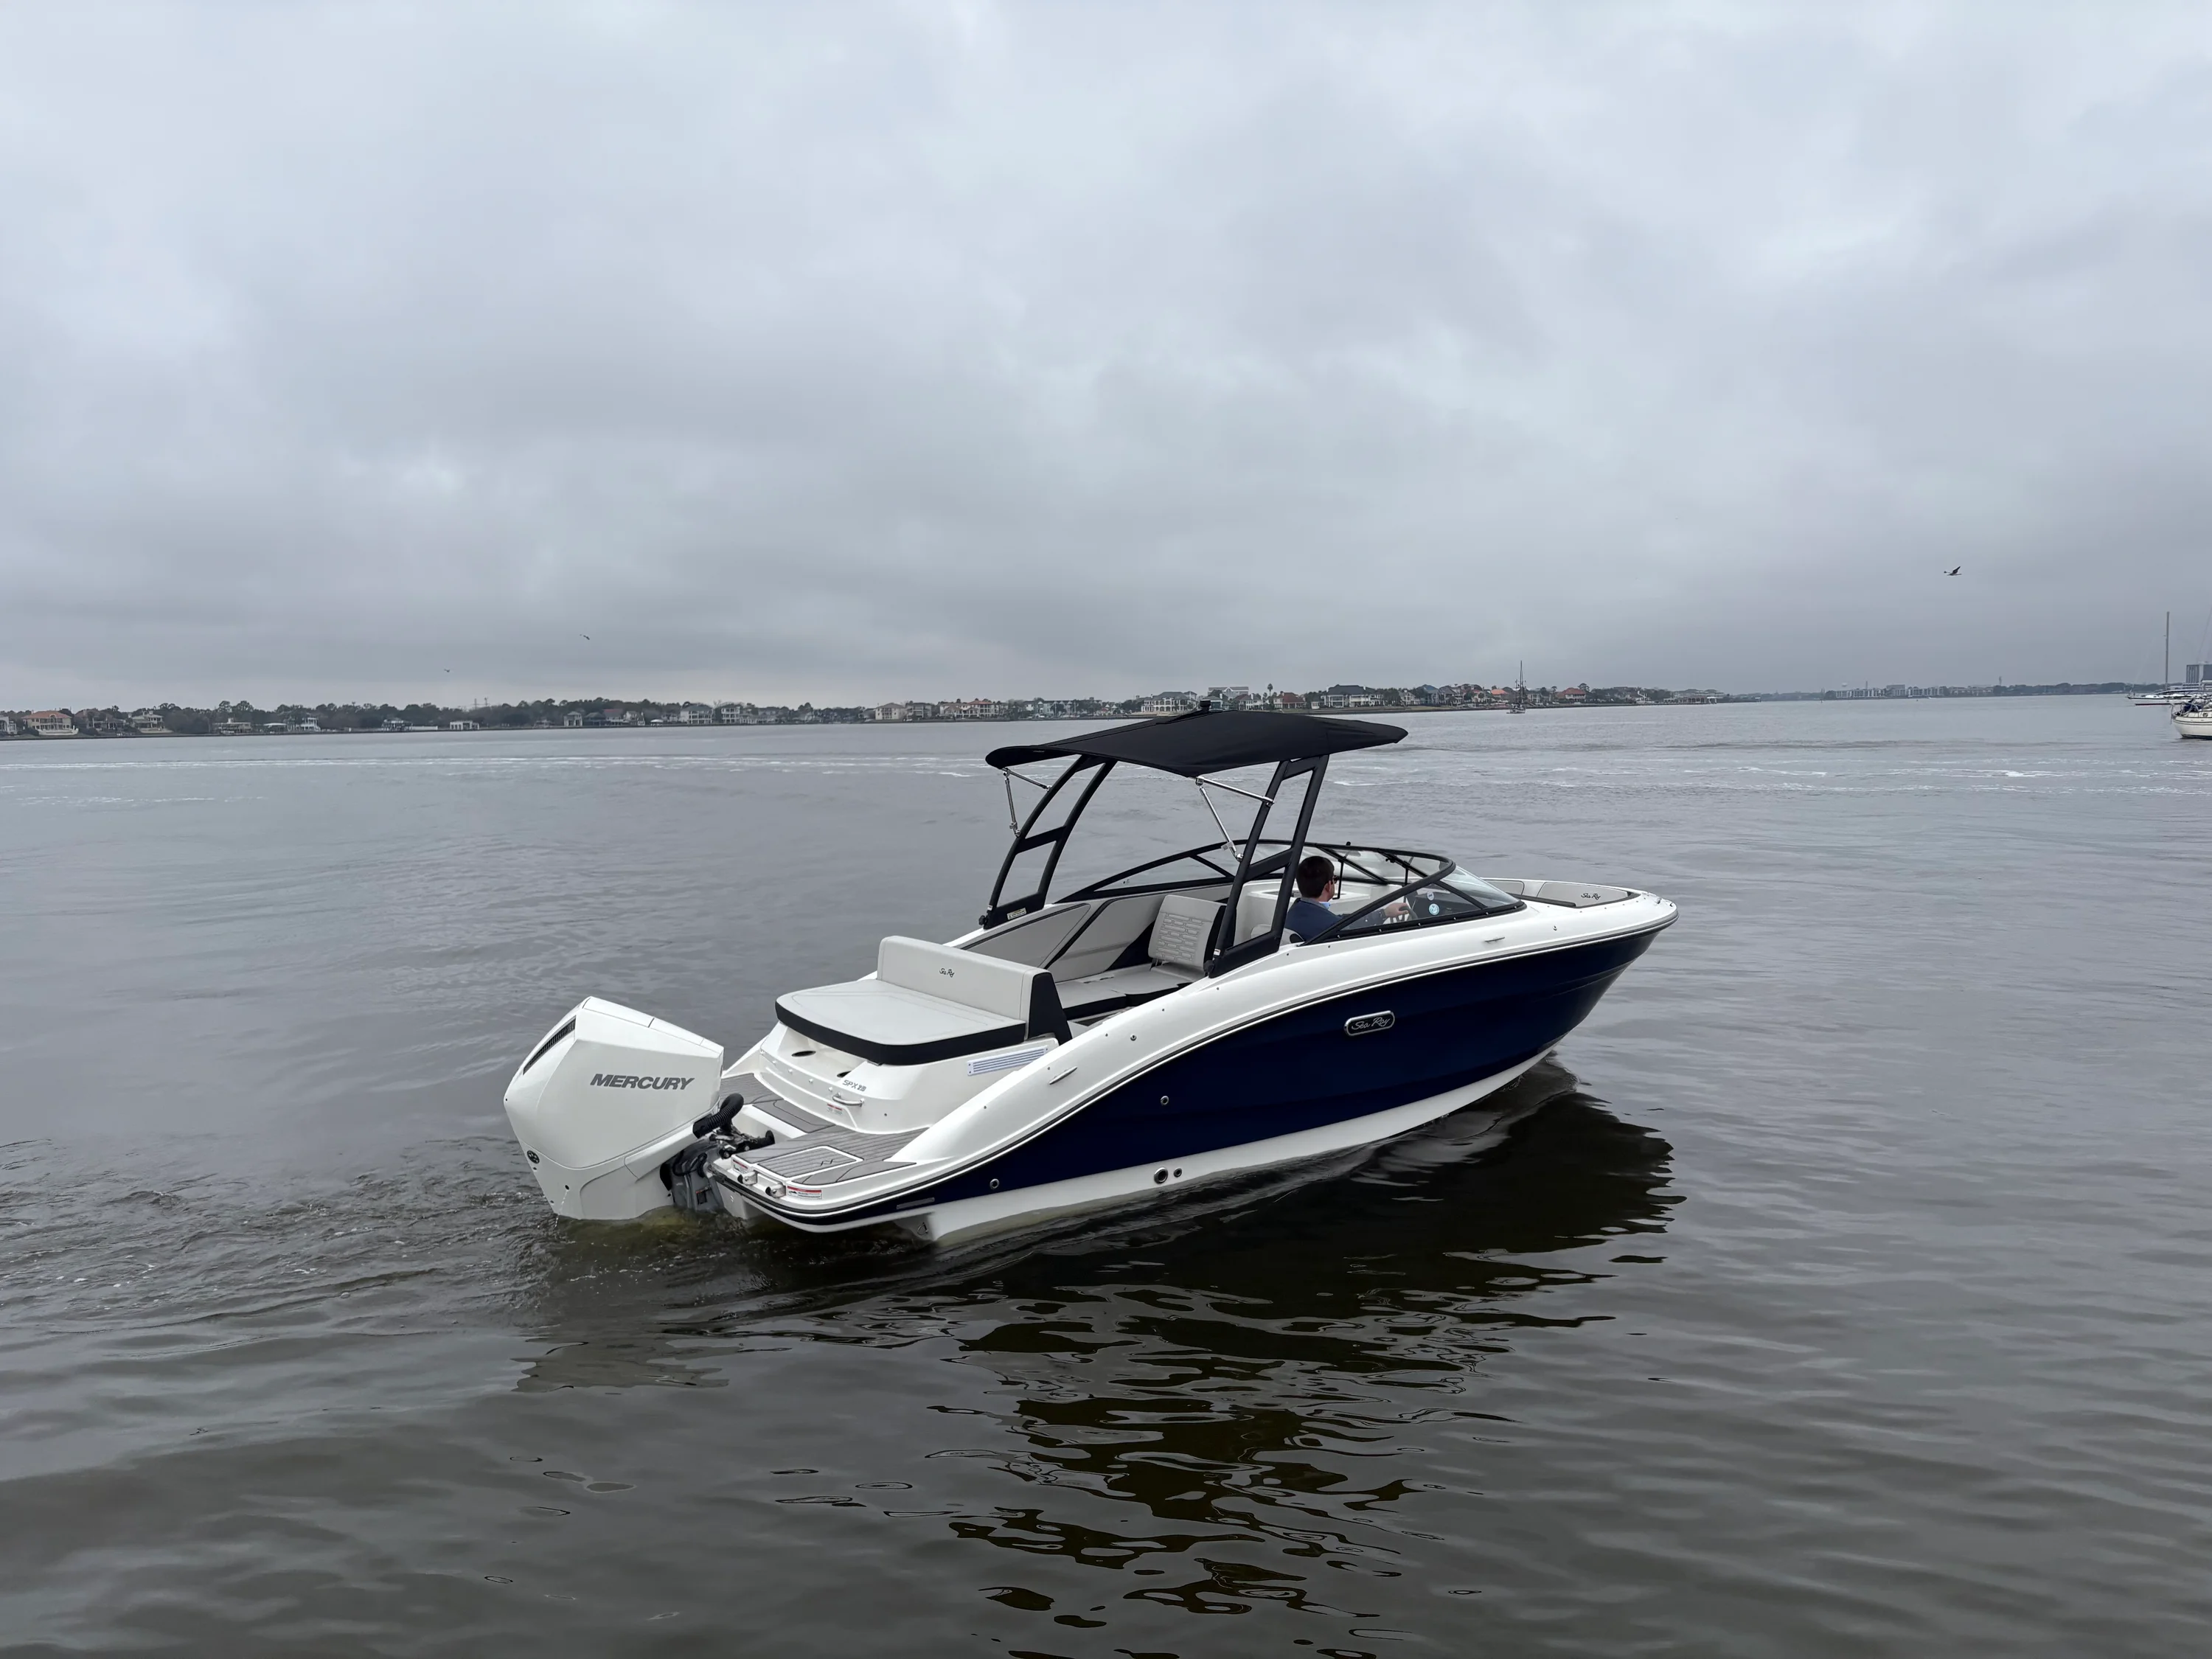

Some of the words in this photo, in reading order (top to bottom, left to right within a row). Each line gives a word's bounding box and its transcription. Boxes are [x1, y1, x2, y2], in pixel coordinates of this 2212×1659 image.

[1351, 1020, 1371, 1030] Sea
[1371, 1017, 1391, 1027] Ray
[590, 1073, 695, 1091] MERCURY
